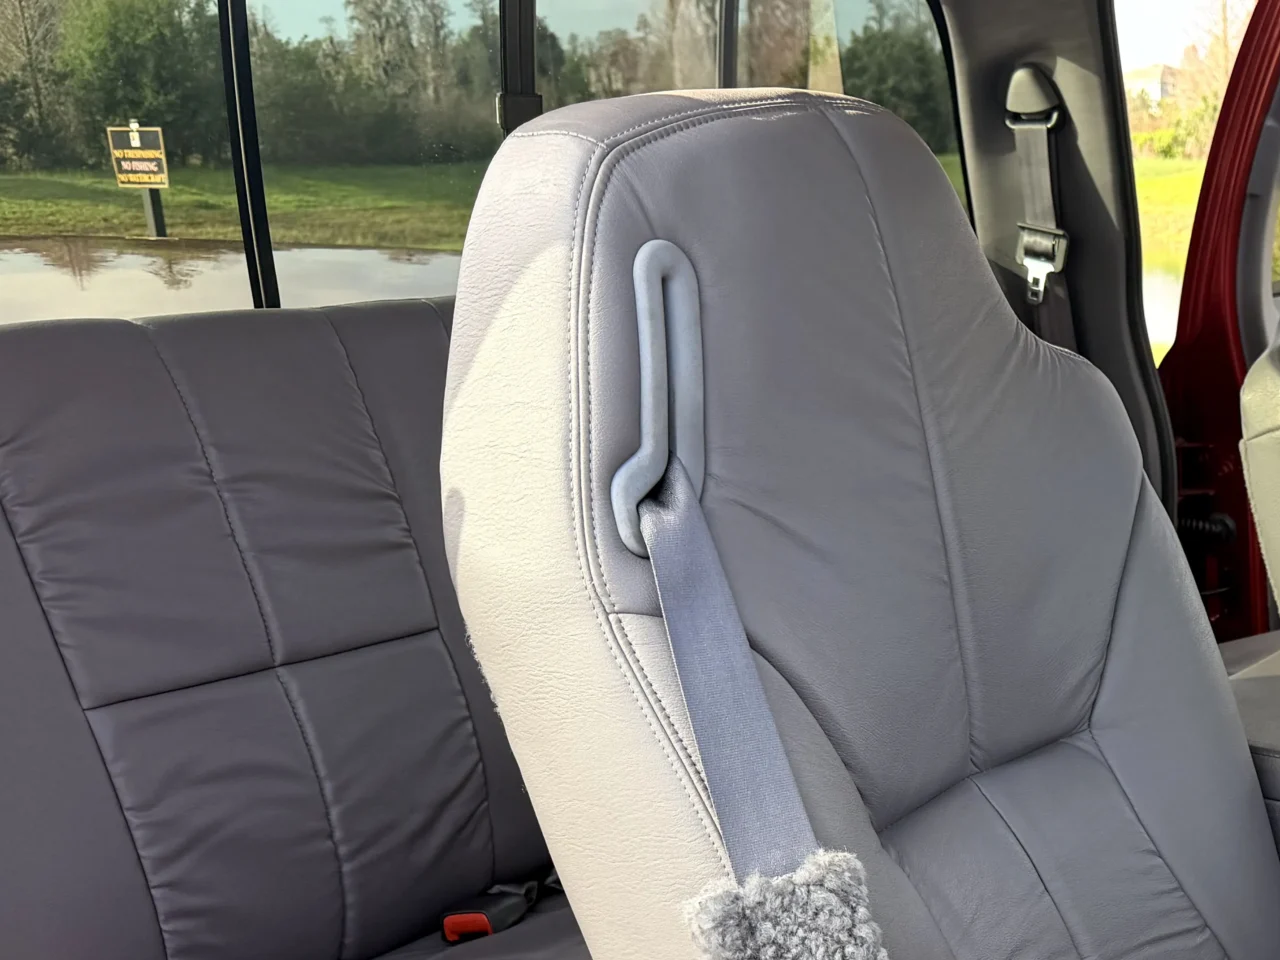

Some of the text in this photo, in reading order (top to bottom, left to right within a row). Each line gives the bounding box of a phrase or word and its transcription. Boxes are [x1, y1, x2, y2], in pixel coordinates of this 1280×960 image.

[113, 150, 124, 159] NO
[121, 160, 159, 172] NO FISHING
[118, 174, 129, 182] NO
